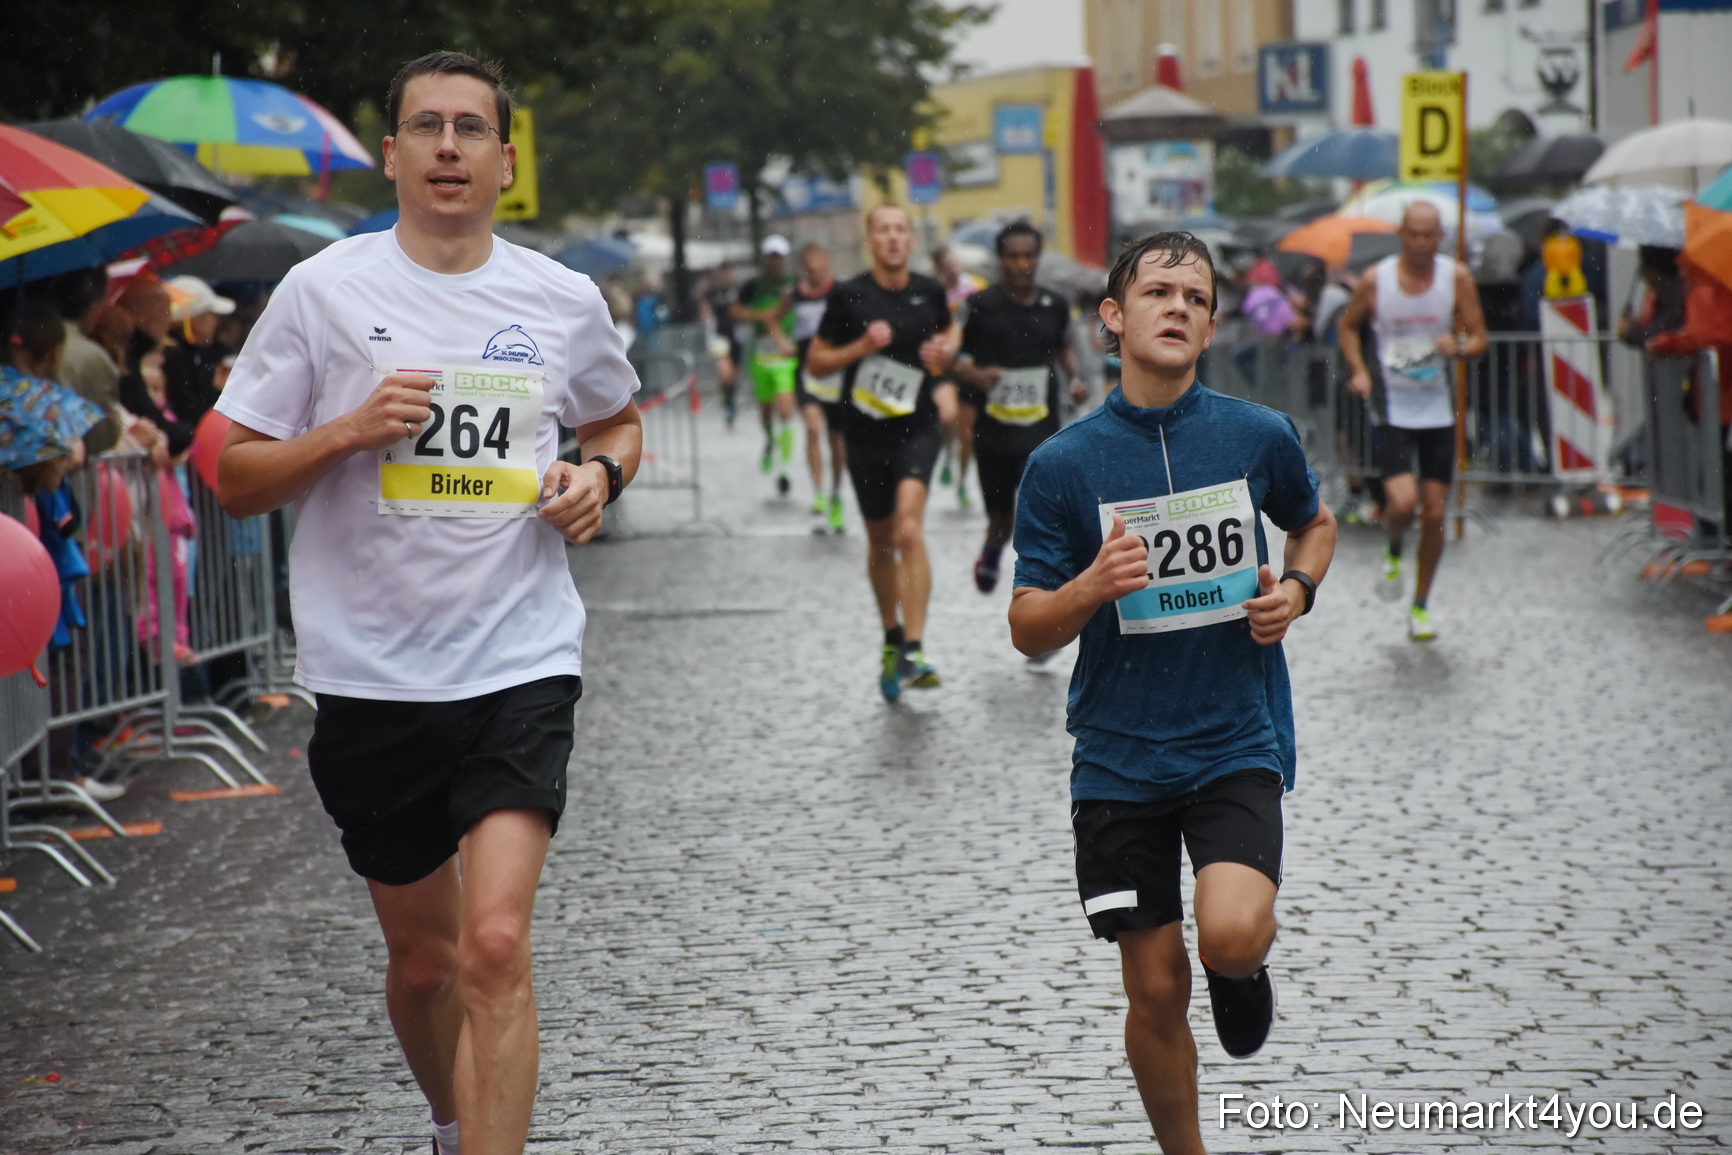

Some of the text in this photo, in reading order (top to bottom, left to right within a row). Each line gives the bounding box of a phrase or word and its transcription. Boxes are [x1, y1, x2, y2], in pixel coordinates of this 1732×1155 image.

[1420, 106, 1451, 156] D
[455, 372, 529, 394] BOCK
[414, 403, 511, 459] 264
[385, 452, 392, 462] A
[431, 473, 494, 496] Birker
[1167, 488, 1238, 516] BOCK
[1124, 513, 1161, 525] uerMarkt
[1159, 585, 1225, 612] Robert
